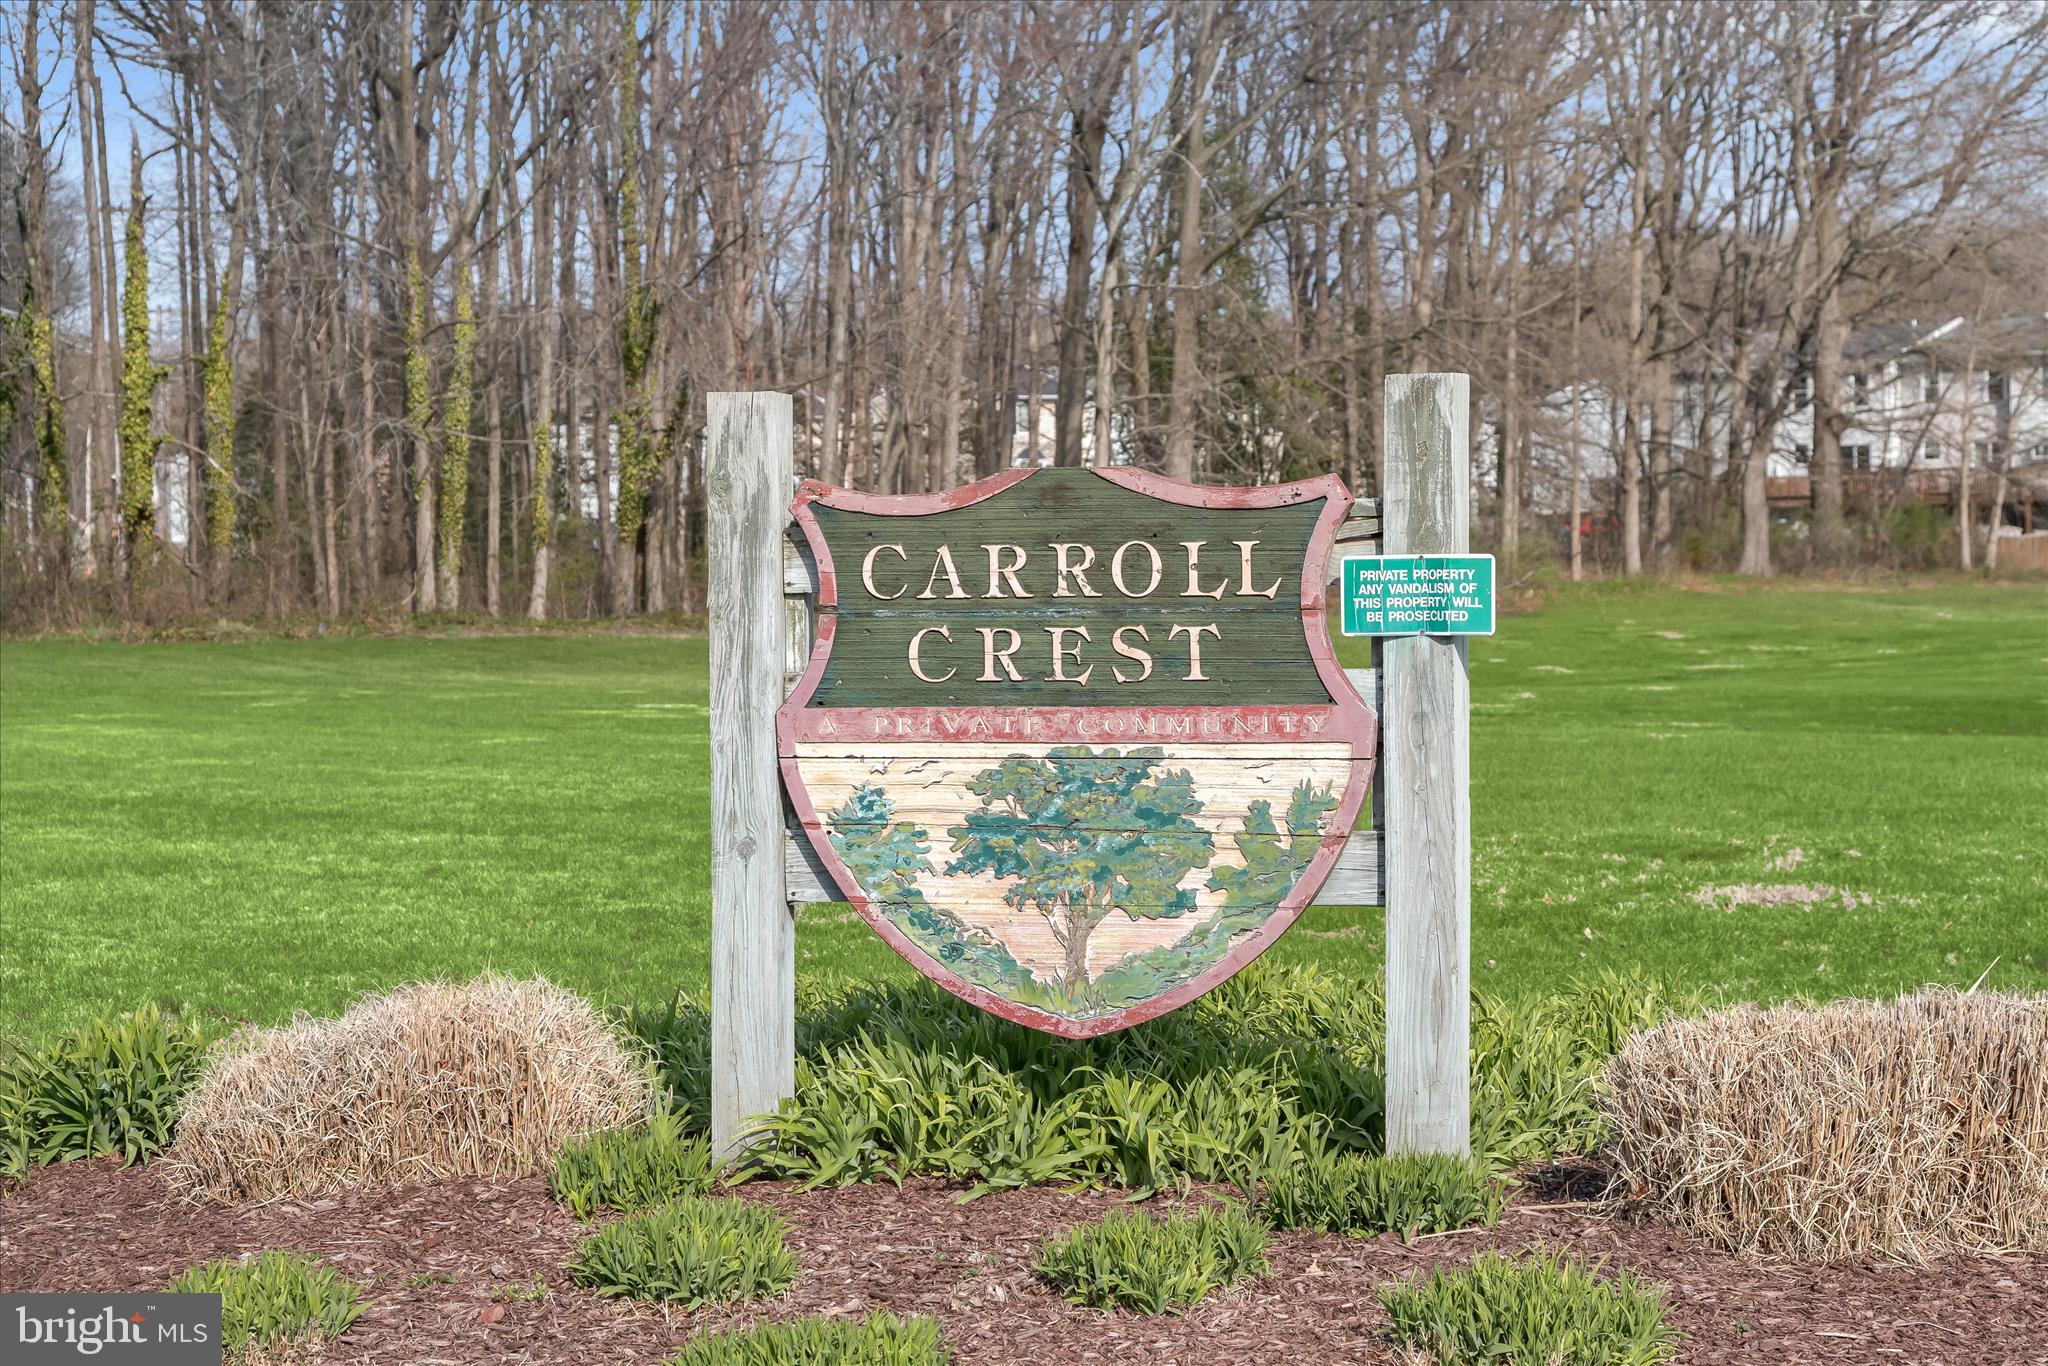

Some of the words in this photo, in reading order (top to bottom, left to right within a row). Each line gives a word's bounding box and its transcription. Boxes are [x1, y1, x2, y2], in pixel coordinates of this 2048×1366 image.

[861, 539, 1282, 600] CARROLL
[1360, 569, 1408, 581] PRIVATE
[1413, 569, 1475, 580] PROPERTY
[1358, 583, 1383, 595] ANY
[1388, 583, 1454, 594] VANDALISM
[1459, 582, 1478, 594] OF
[1353, 597, 1381, 609] THIS
[1386, 597, 1447, 608] PROPERTY
[1452, 597, 1483, 608] WILL
[1366, 611, 1383, 623] BE
[1388, 610, 1469, 622] PROSECUTED
[908, 623, 1222, 685] CREST
[818, 714, 837, 734] A
[874, 713, 1043, 734] PRIVATE
[1078, 713, 1328, 735] COMMUNITY
